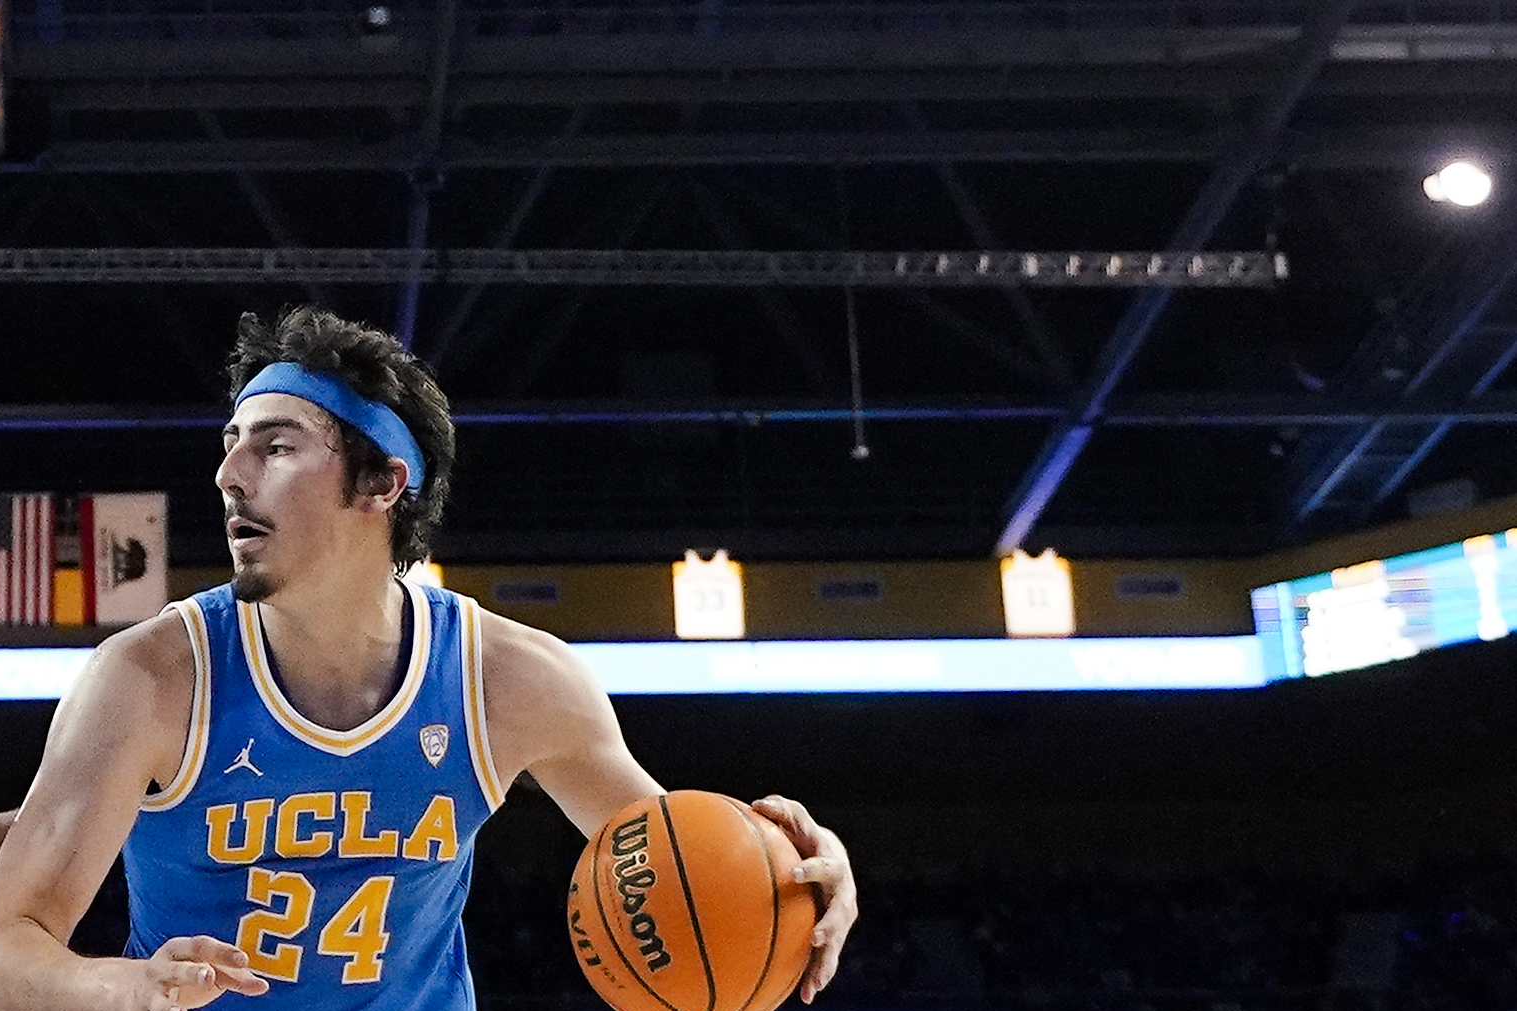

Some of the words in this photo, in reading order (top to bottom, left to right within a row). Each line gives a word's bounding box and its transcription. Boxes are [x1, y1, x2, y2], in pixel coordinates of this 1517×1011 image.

[205, 791, 459, 864] UCLA
[235, 867, 395, 985] 24
[611, 812, 673, 973] Wilson
